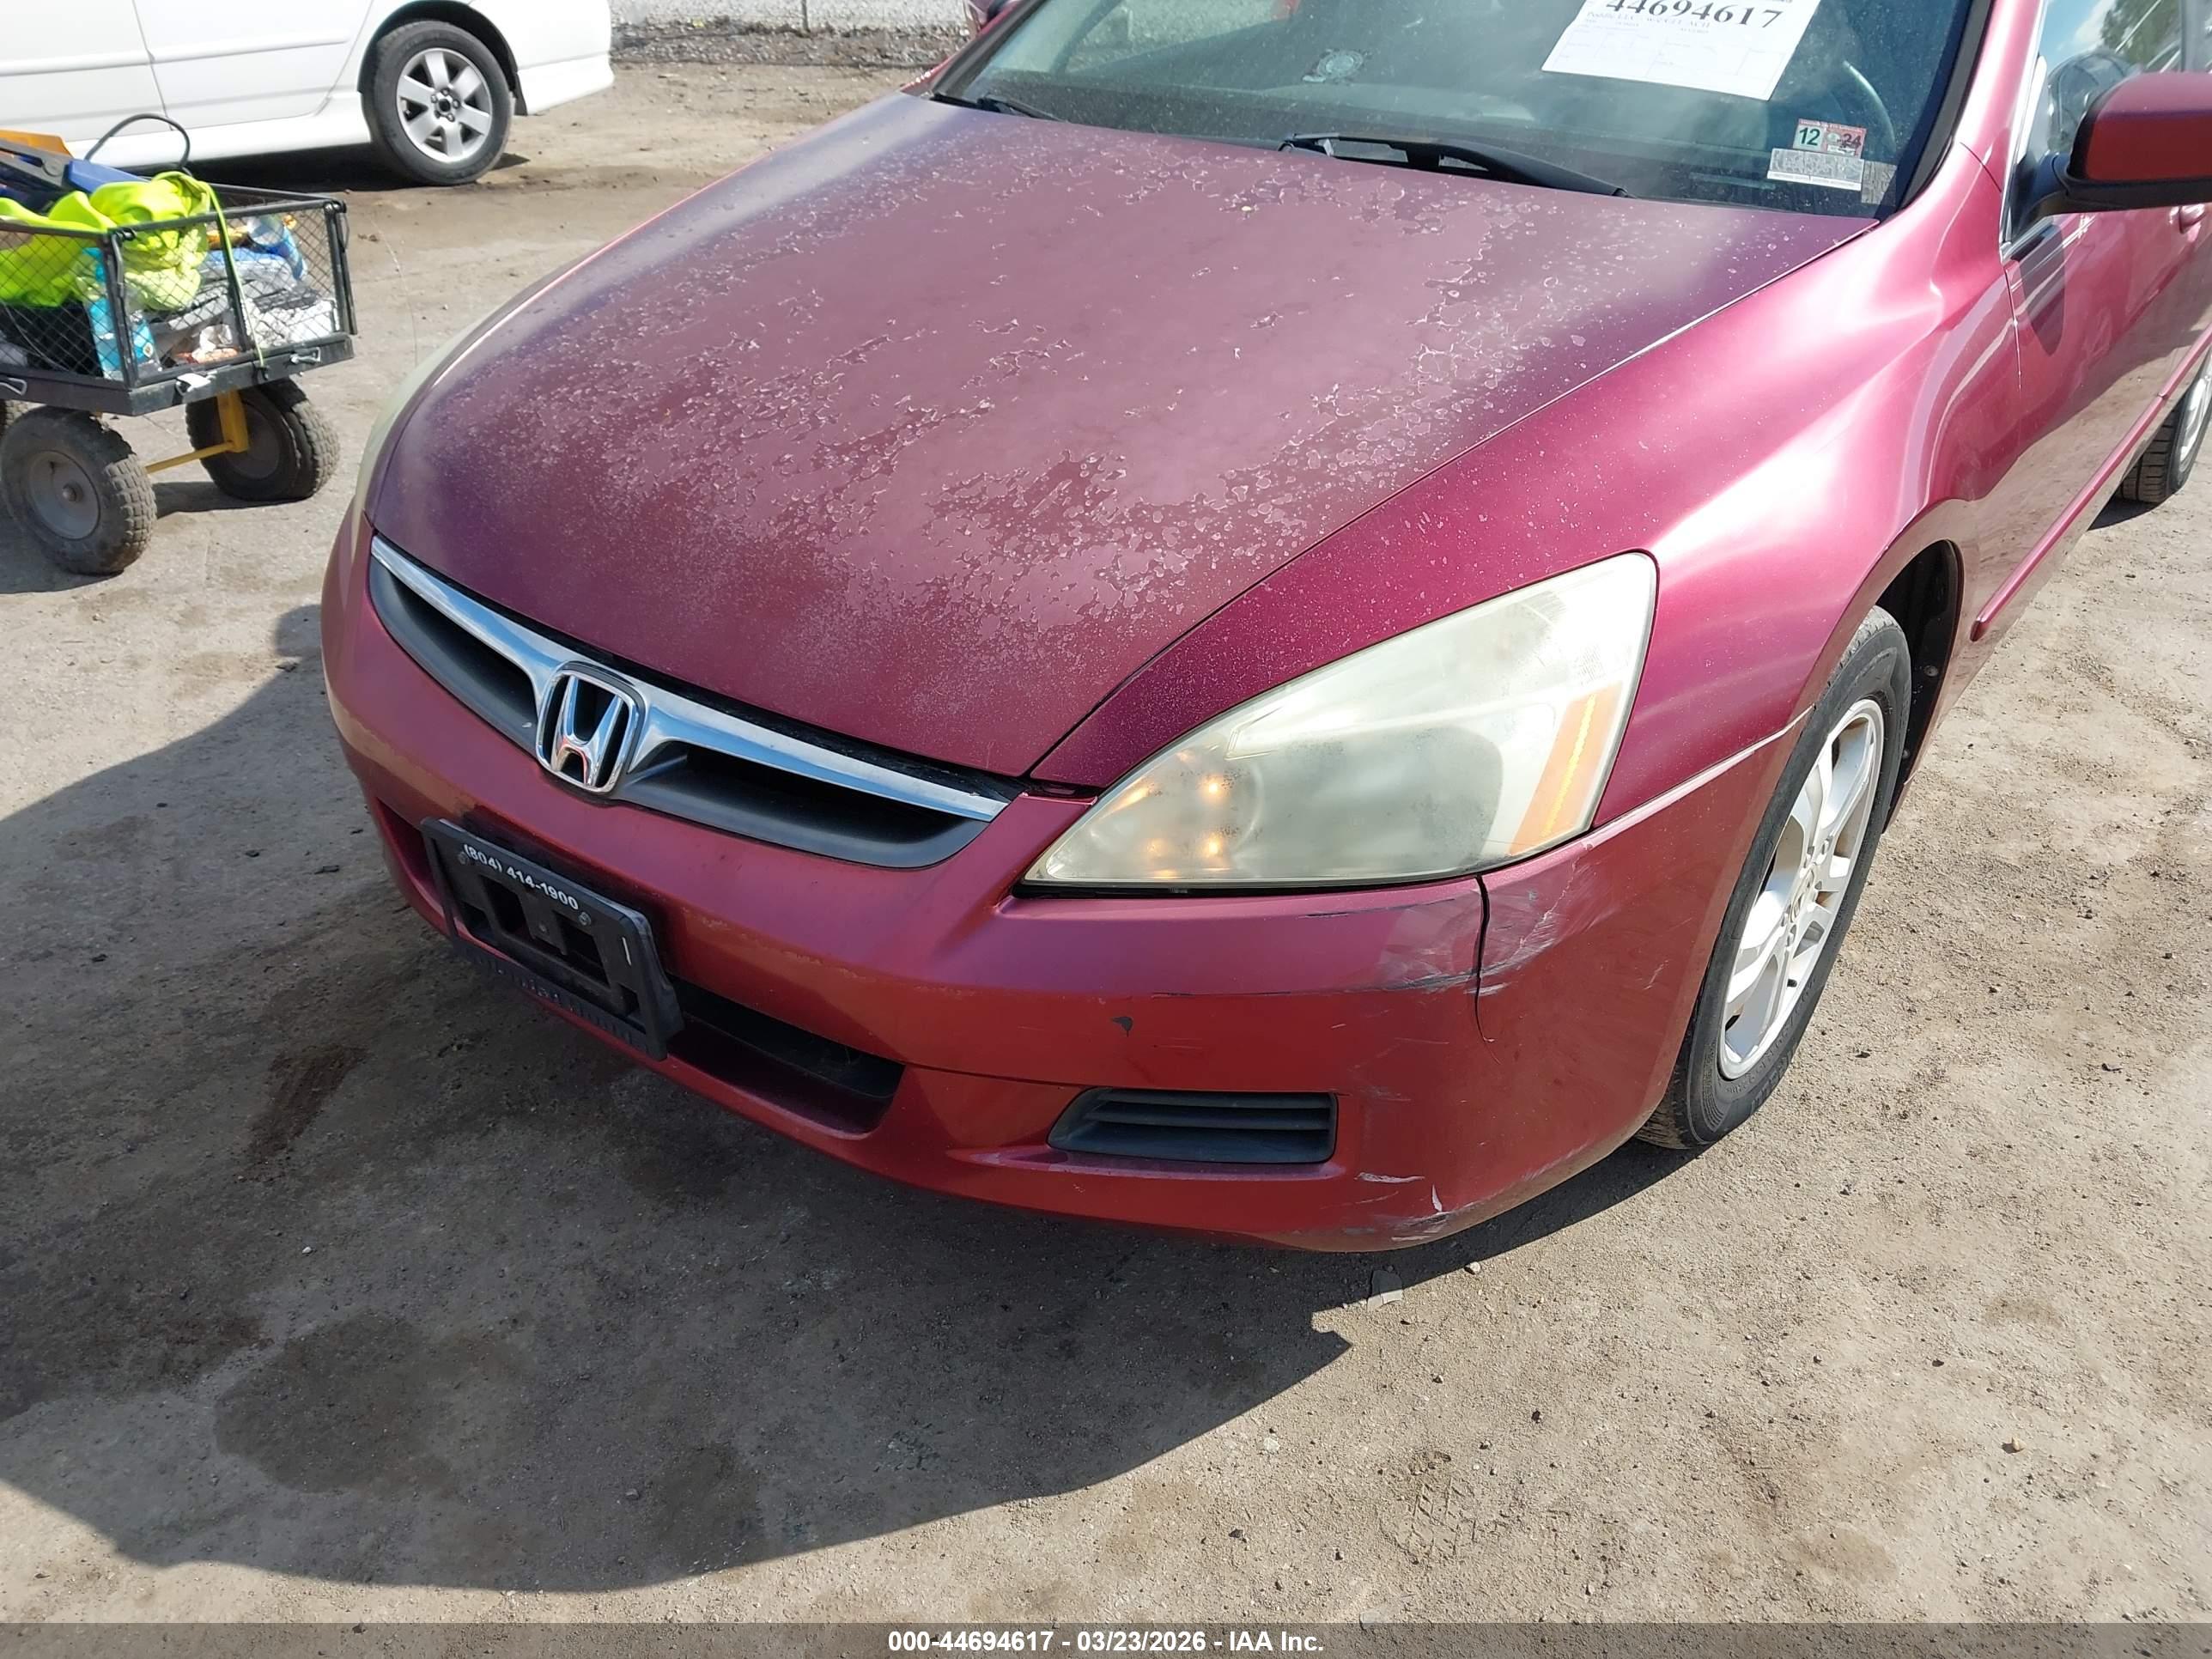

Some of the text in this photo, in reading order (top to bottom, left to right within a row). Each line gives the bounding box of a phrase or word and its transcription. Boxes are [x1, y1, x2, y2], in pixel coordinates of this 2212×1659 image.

[1606, 0, 1784, 27] 44694617
[1799, 127, 1820, 146] 12
[464, 844, 579, 910] (804) 414-1900
